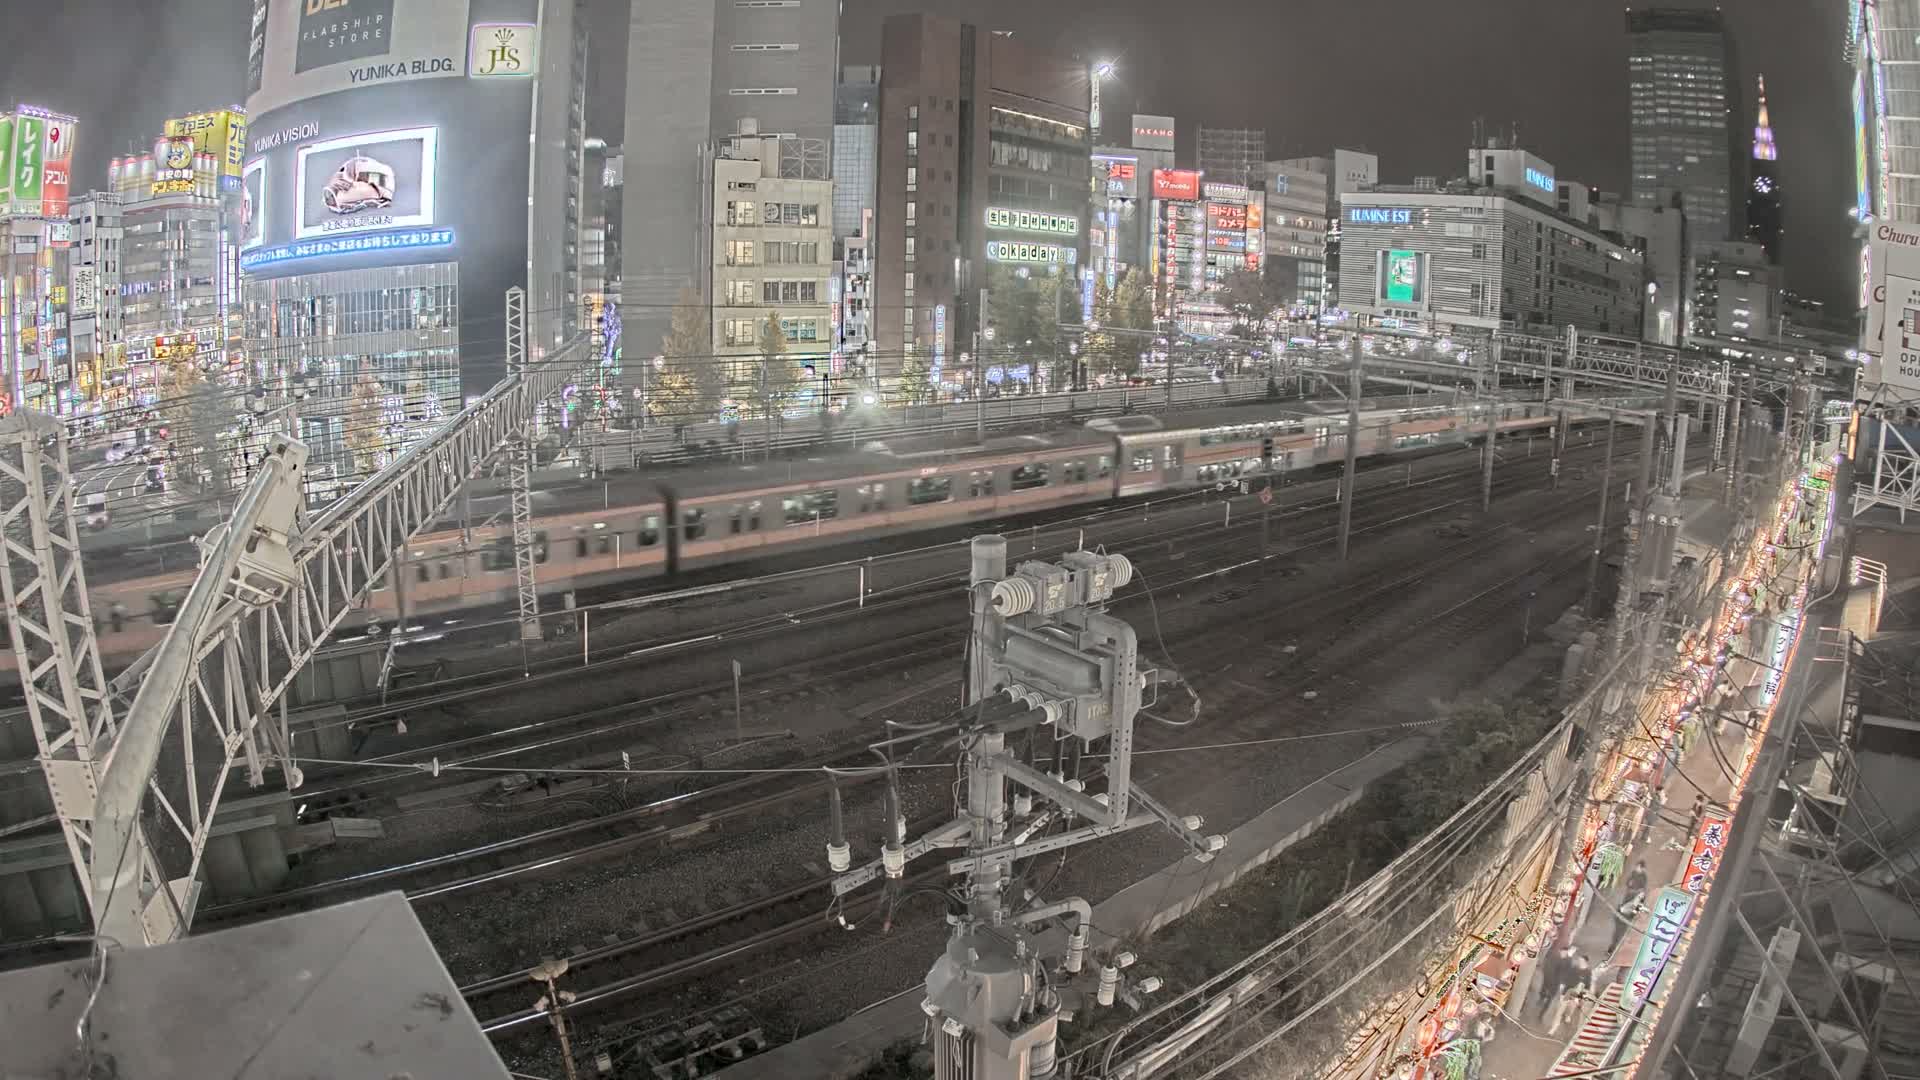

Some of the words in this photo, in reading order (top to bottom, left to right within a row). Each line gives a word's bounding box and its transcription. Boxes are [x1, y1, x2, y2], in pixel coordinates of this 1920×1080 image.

[303, 15, 383, 41] FLAGSHIP
[328, 29, 382, 48] STORE
[350, 62, 408, 83] YUNIKA
[411, 58, 455, 75] BLDG.
[254, 132, 281, 153] YUNIKA
[282, 120, 319, 144] VISION
[1134, 127, 1174, 138] TAKANO
[20, 121, 37, 188] レイク
[45, 169, 68, 185] アコム
[1208, 205, 1246, 217] ヨドバシ
[1351, 209, 1390, 223] LUMINE
[1392, 209, 1411, 223] EST
[1218, 218, 1246, 229] カメラ
[1901, 353, 1920, 365] OP
